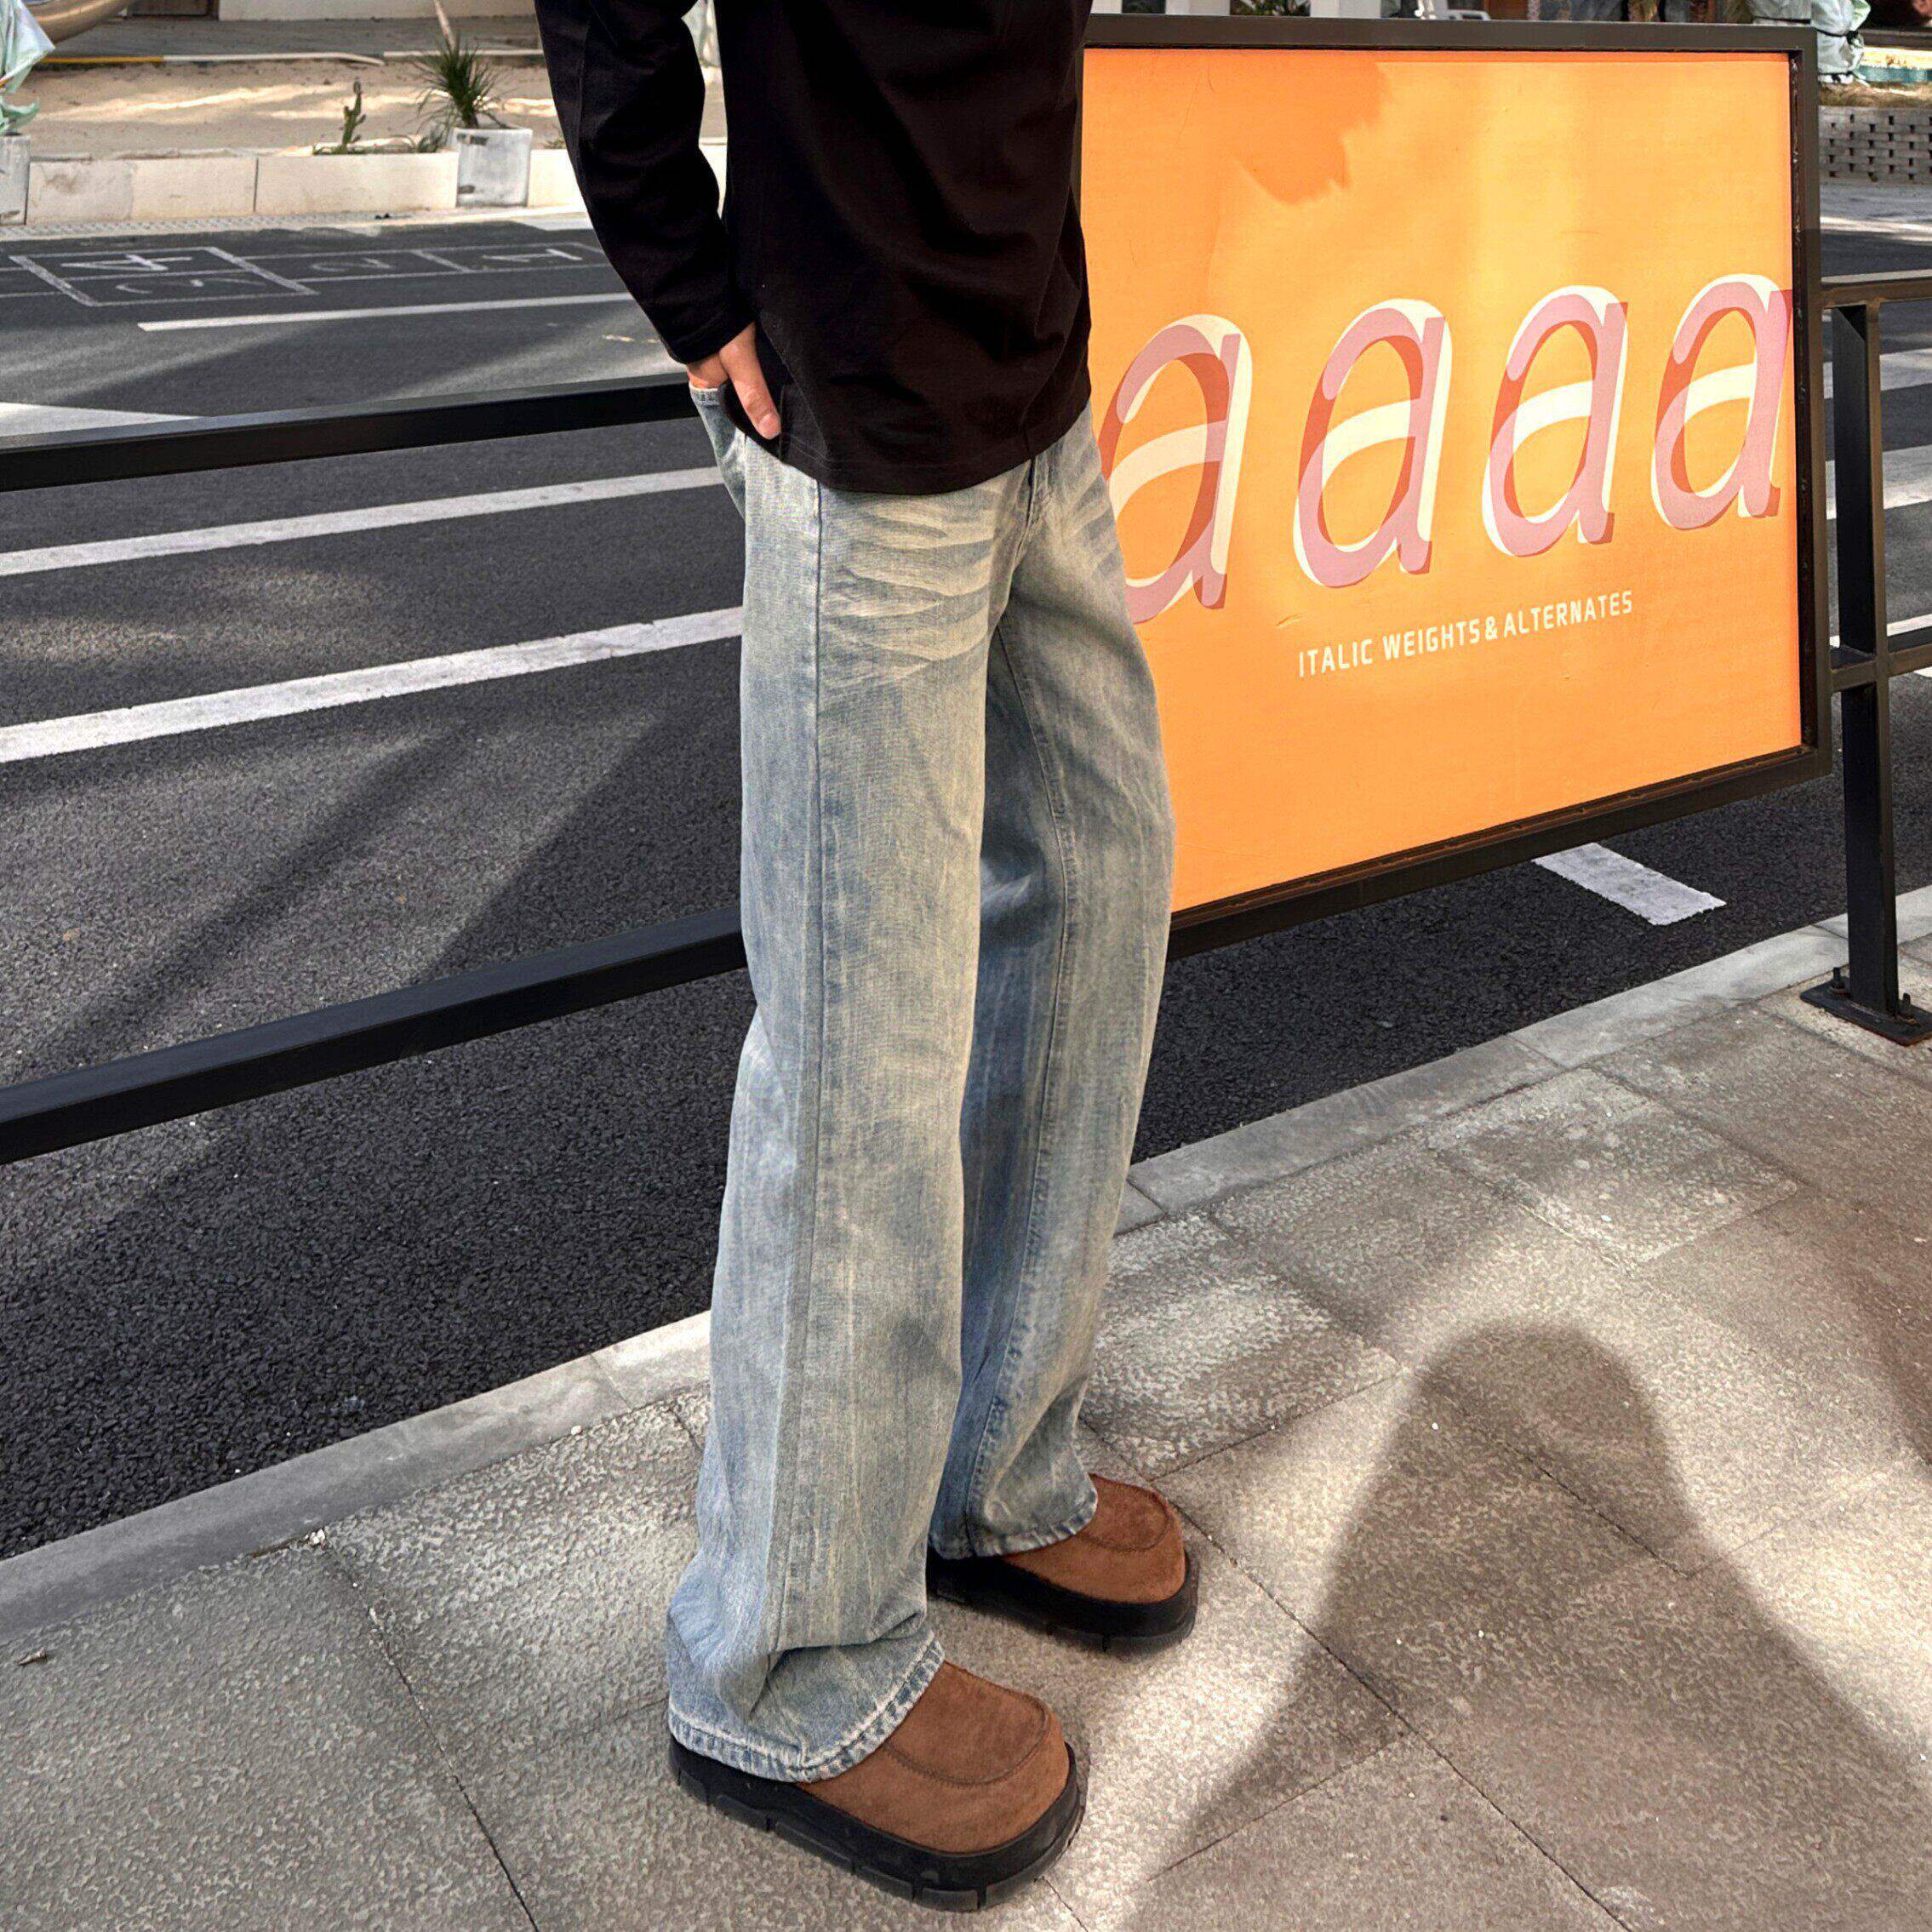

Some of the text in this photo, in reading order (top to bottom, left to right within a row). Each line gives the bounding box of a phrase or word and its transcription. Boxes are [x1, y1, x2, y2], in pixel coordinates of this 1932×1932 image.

[1298, 590, 1633, 677] ITALIC WEIGHTS & ALTERNATES
